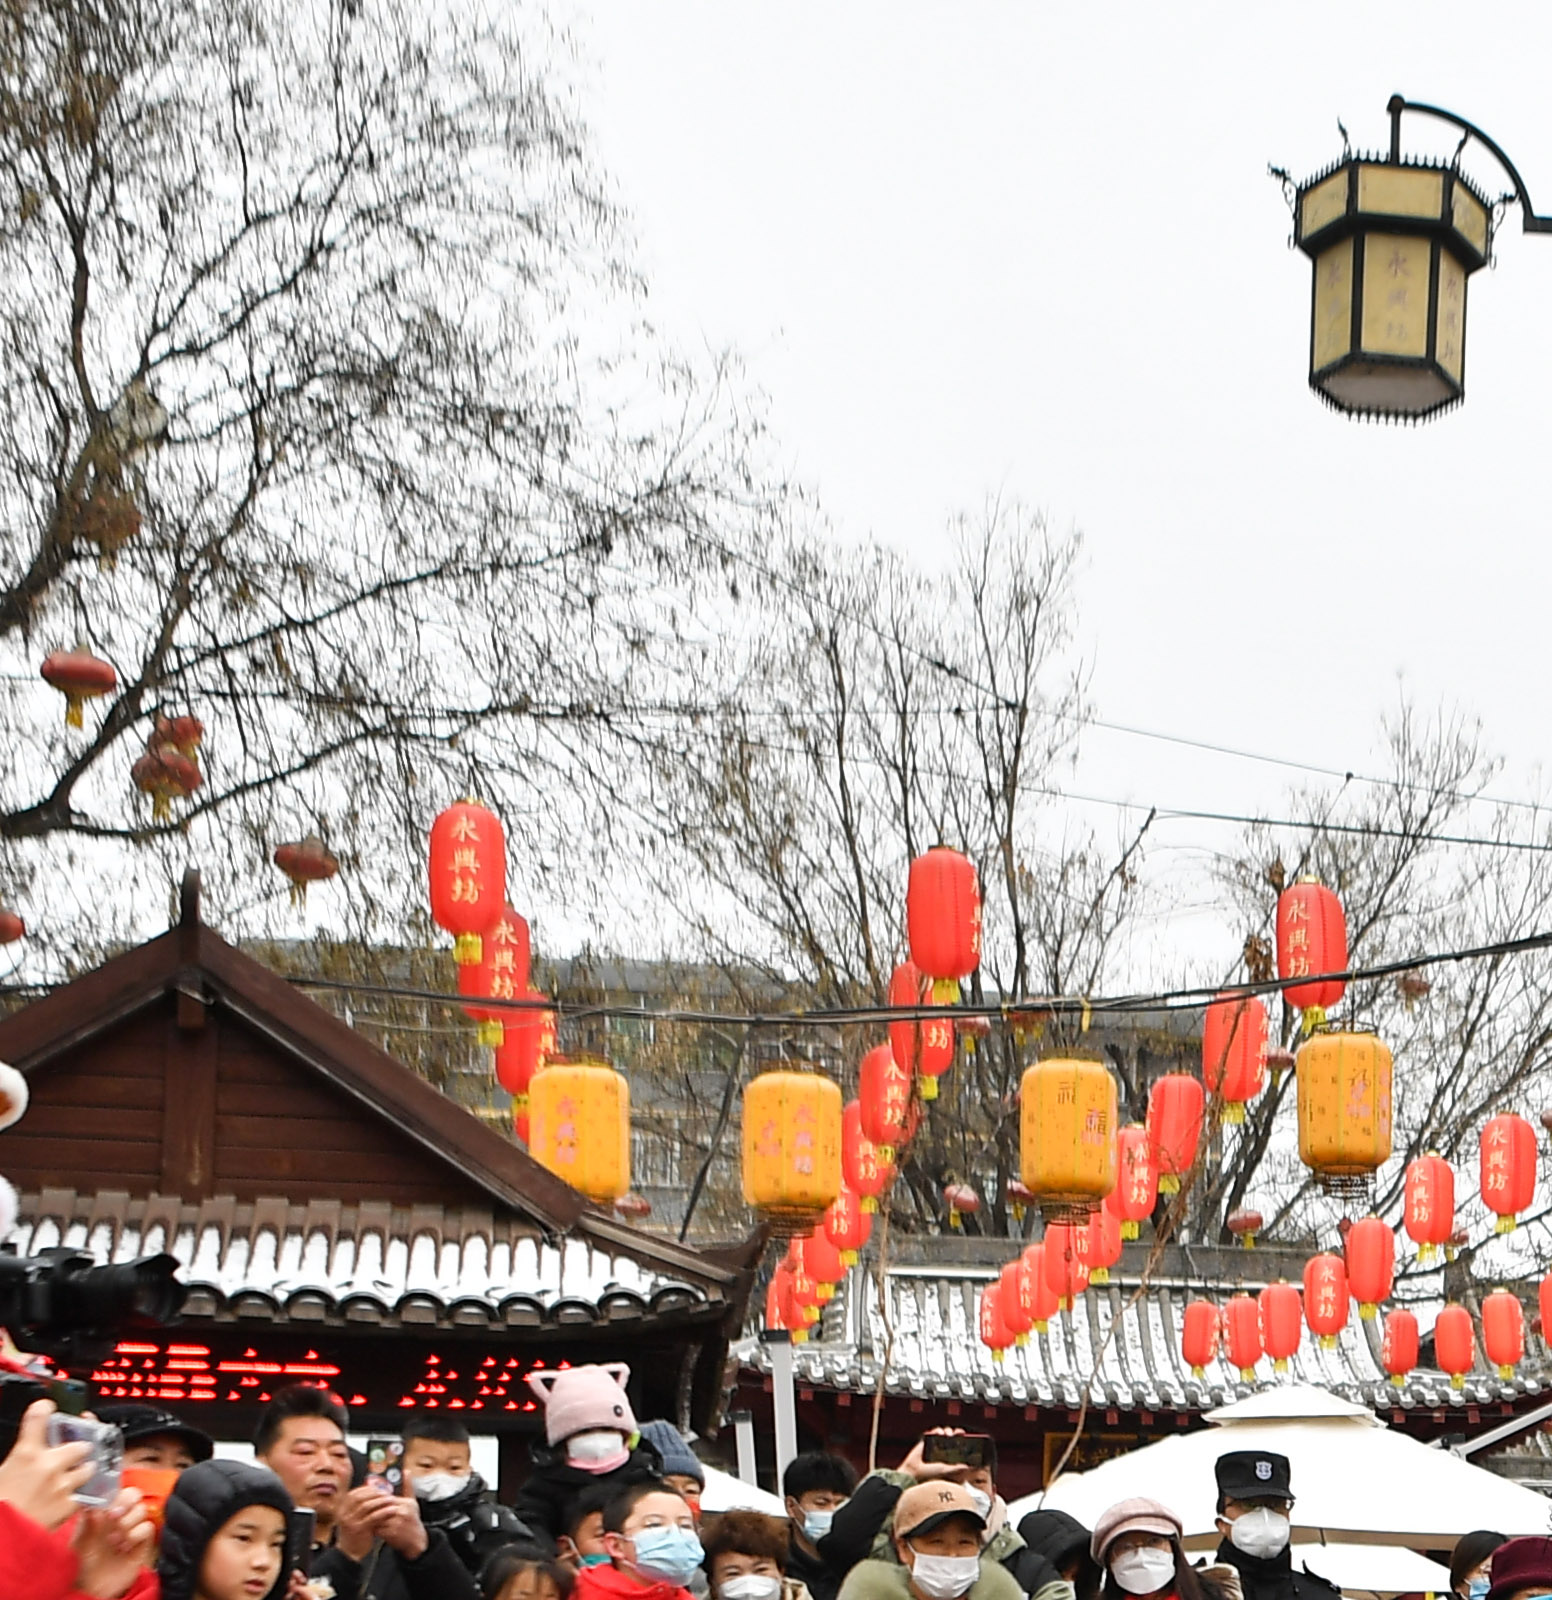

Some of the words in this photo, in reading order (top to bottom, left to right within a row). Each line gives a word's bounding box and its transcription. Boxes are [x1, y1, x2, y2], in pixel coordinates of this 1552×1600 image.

[449, 815, 484, 904] 永興坊
[489, 919, 518, 1000] 永興坊
[1487, 1126, 1509, 1191] 永興坊
[1409, 1164, 1432, 1223] 永興坊
[1317, 1265, 1337, 1318] 永興坊
